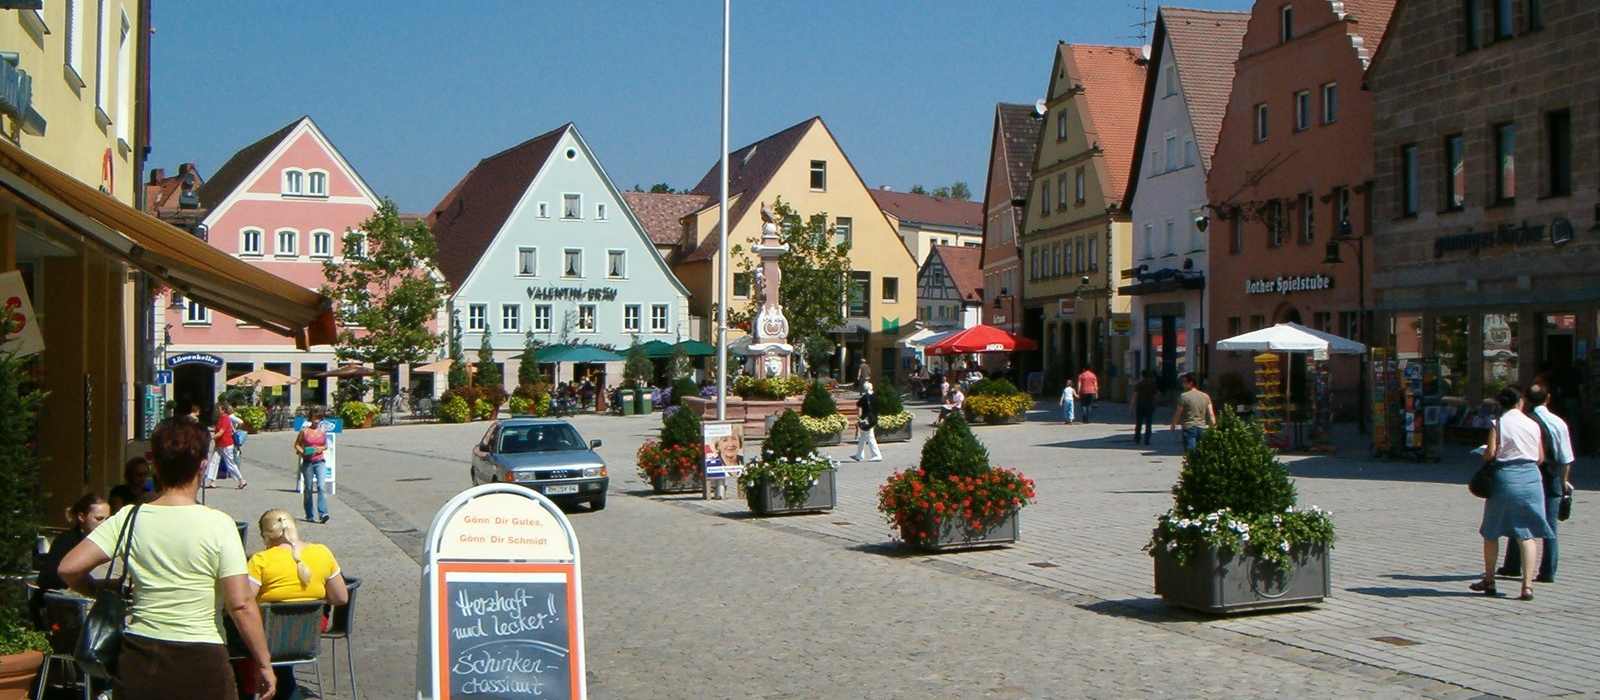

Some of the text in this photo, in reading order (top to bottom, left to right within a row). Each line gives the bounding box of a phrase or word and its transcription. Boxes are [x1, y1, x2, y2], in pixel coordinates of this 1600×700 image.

[1247, 275, 1330, 295] Rother Spielstube
[464, 515, 490, 524] Gönn
[495, 517, 509, 525] Dir
[460, 534, 486, 543] Gönn
[508, 537, 547, 545] Schmidt
[456, 588, 534, 619] Herzhaft
